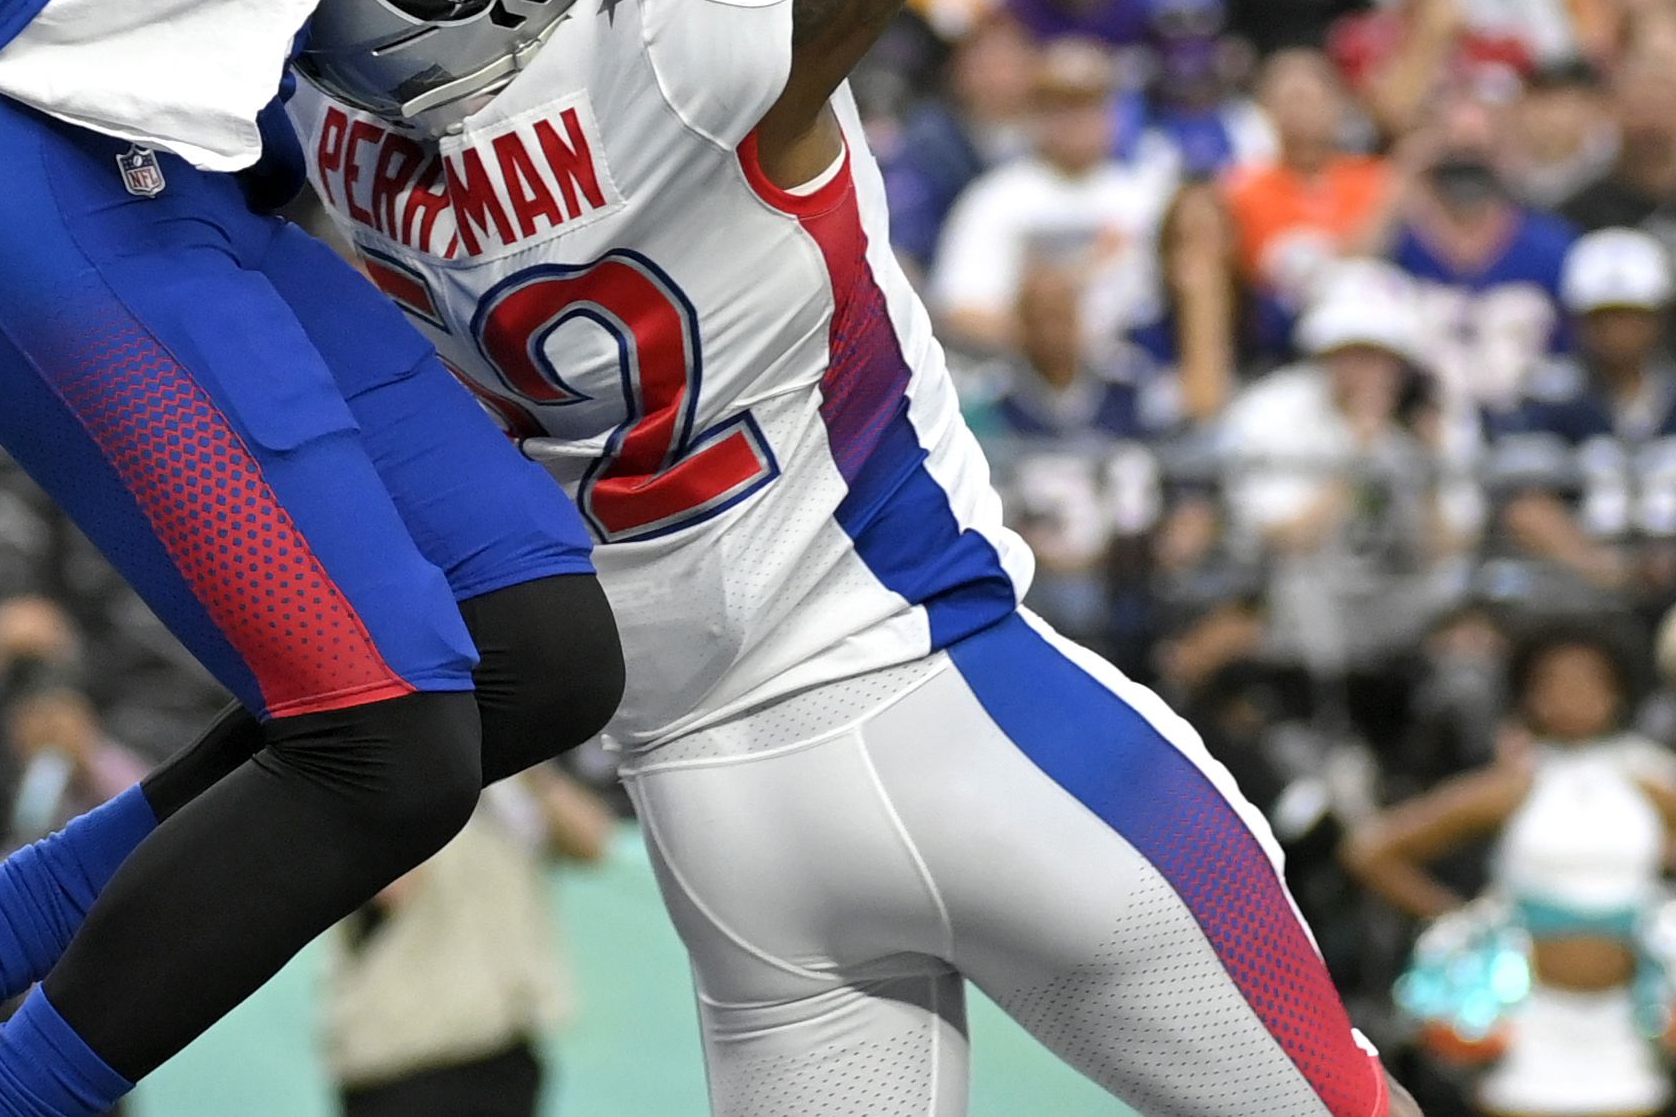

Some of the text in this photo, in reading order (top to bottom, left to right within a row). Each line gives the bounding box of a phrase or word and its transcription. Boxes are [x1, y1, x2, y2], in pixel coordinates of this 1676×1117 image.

[127, 168, 161, 191] NFL
[317, 105, 607, 260] PERRMAN
[356, 240, 781, 545] 2
